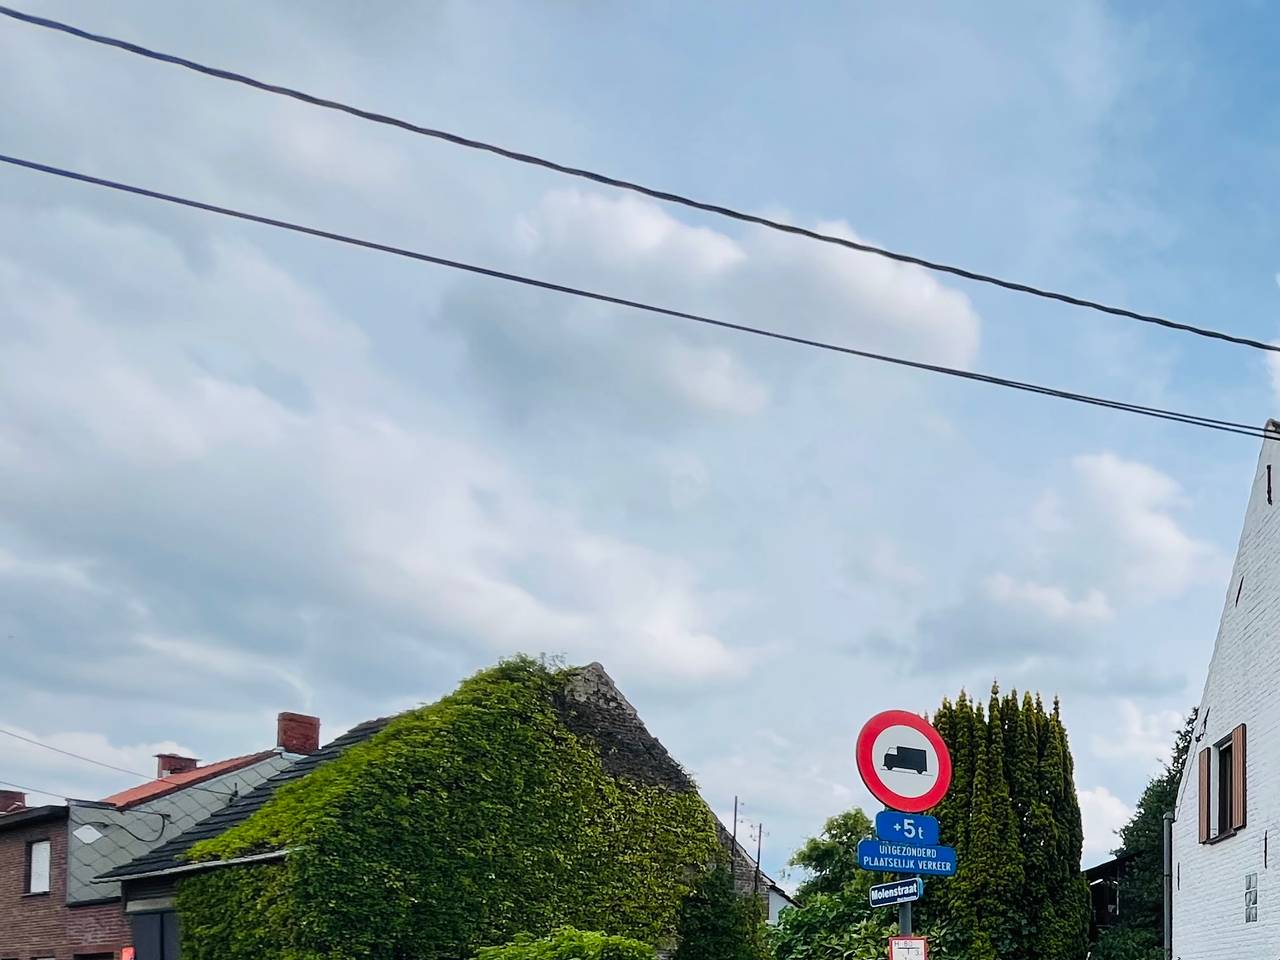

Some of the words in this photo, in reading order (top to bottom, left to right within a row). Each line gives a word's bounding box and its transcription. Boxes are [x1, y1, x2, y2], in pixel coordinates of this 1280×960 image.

[879, 844, 937, 859] UITGEZONDERD
[863, 856, 915, 869] PLAATSELIJK
[917, 860, 952, 871] VERKEER
[871, 882, 917, 900] Molenstraat
